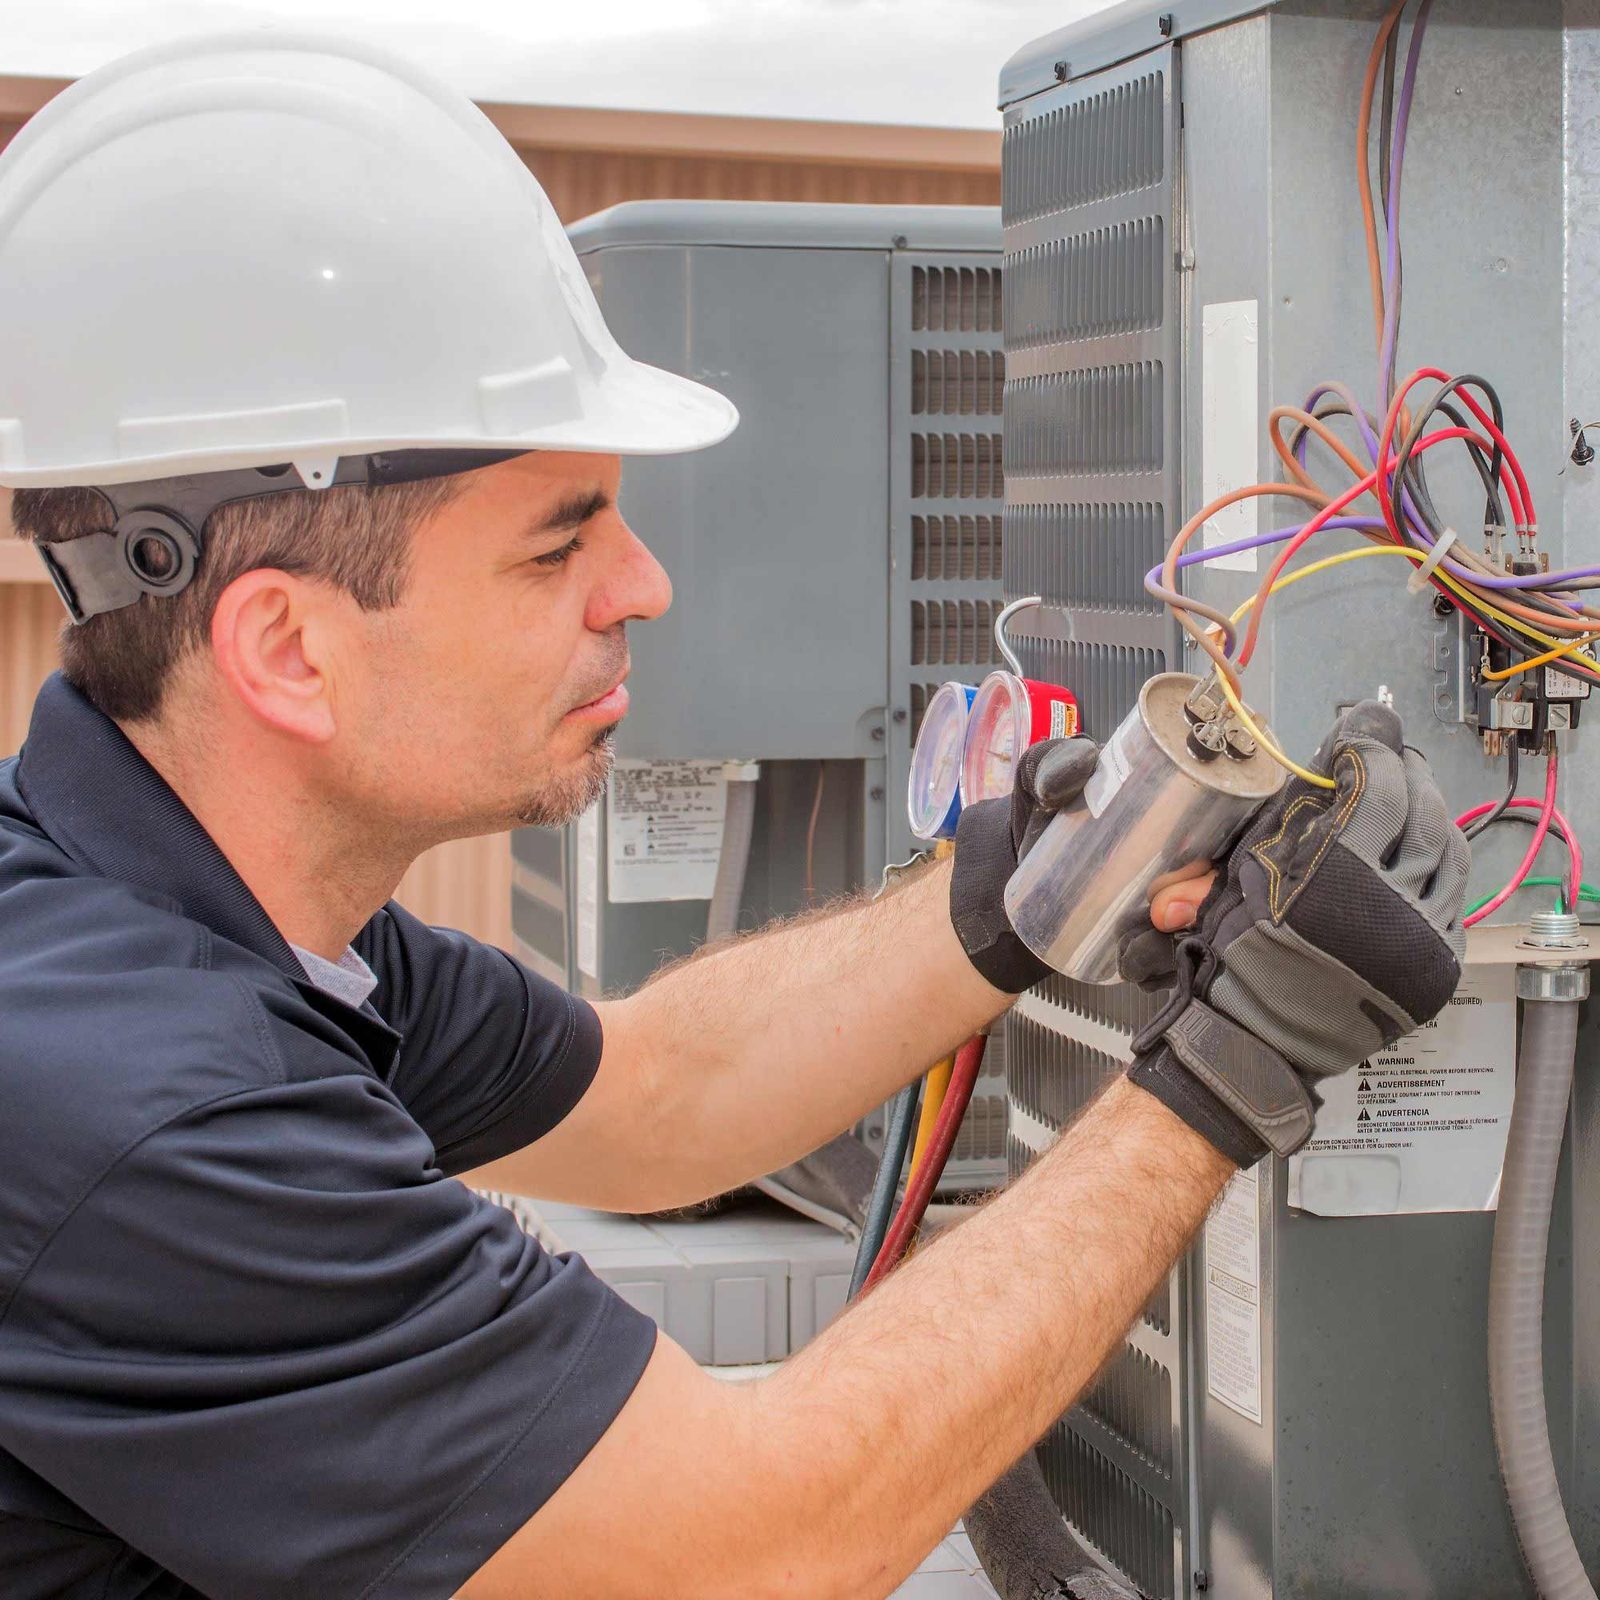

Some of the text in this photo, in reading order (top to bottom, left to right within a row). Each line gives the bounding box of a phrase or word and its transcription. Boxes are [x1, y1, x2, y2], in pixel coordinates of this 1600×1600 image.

[1448, 997, 1482, 1006] REQUIRED)
[1377, 1058, 1415, 1066] WARNING
[1377, 1080, 1445, 1088] ADVERTISSEMENT
[1376, 1109, 1430, 1117] ADVERTENCIA
